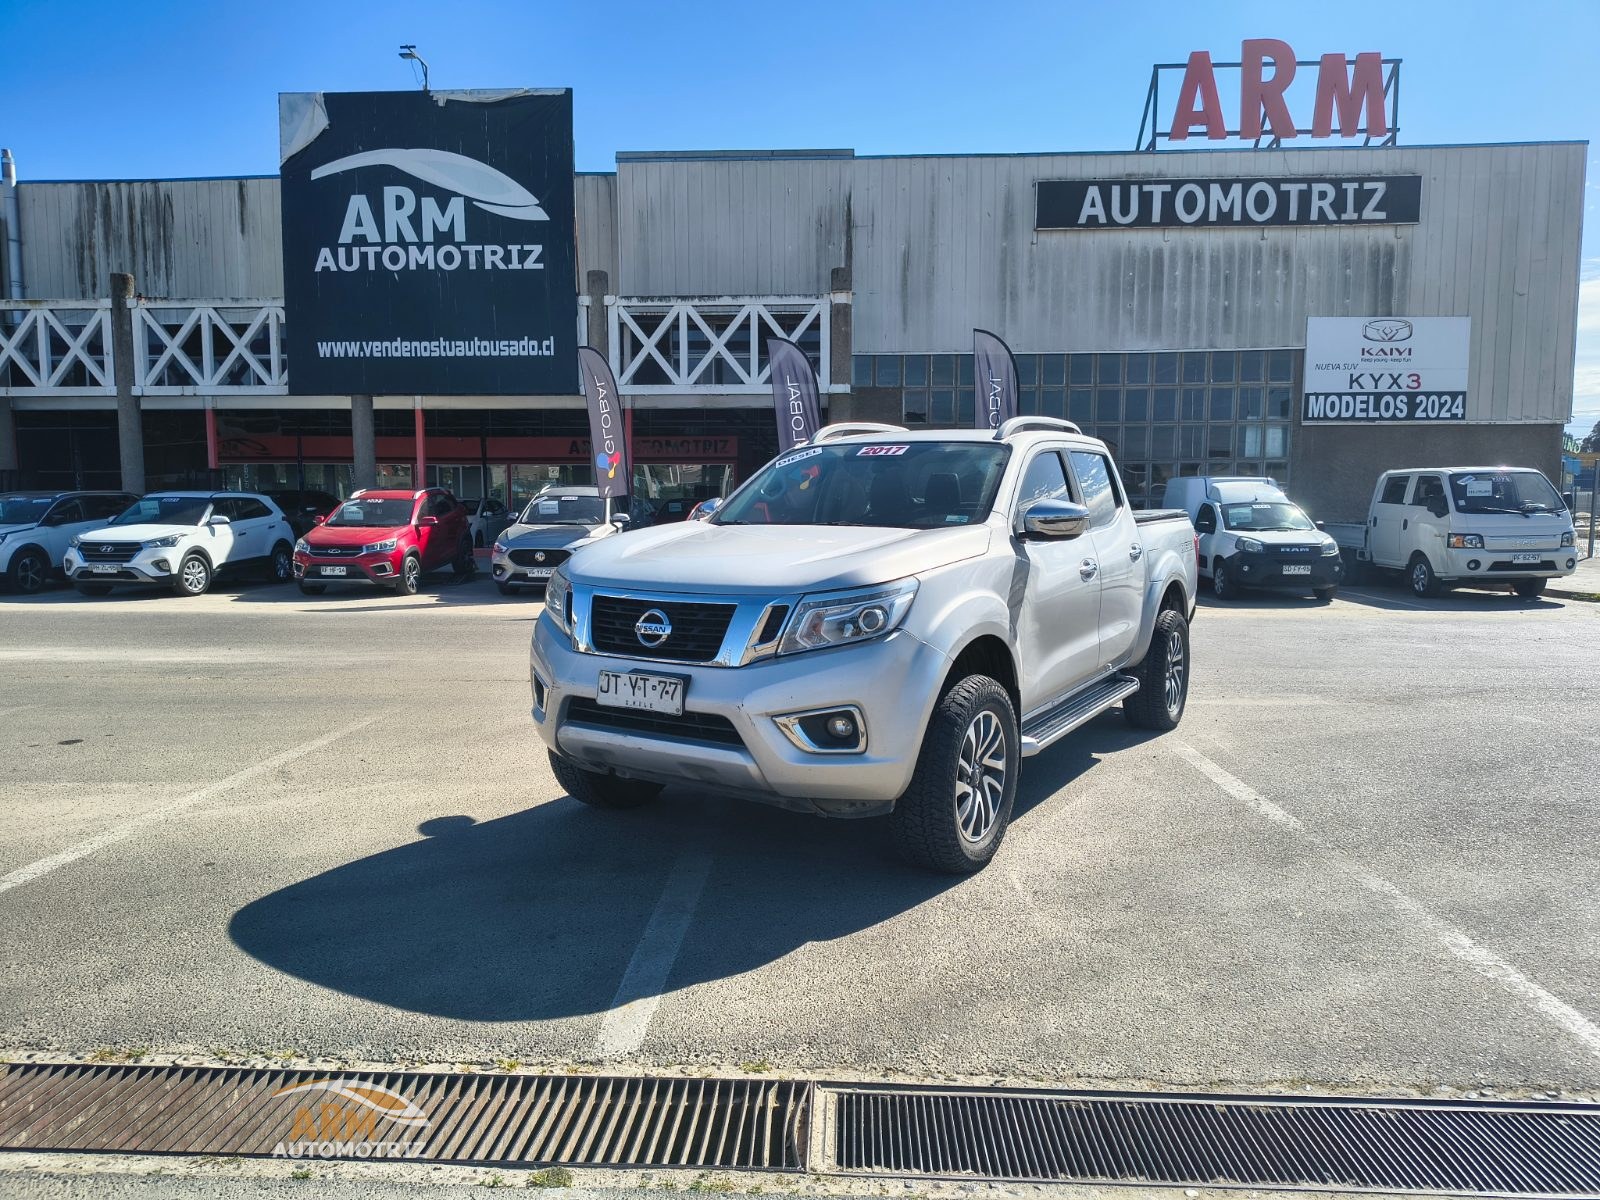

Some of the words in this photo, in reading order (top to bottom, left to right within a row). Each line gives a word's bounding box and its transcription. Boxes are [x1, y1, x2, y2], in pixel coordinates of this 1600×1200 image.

[1168, 38, 1387, 141] ARM
[1077, 181, 1387, 225] AUTOMOTRIZ
[338, 186, 466, 244] ARM
[314, 244, 545, 272] AUTOMOTRIZ
[317, 336, 554, 358] www.vendenostuautousado.cl
[1361, 347, 1412, 356] KAIYI
[1315, 363, 1341, 371] NUEVA
[1342, 363, 1359, 371] SUV
[1348, 373, 1422, 390] KYX3
[1308, 395, 1408, 418] MODELOS
[1414, 395, 1464, 418] 2024
[778, 448, 821, 466] DIESEL
[861, 446, 906, 455] 2017
[637, 624, 666, 633] NISSAN
